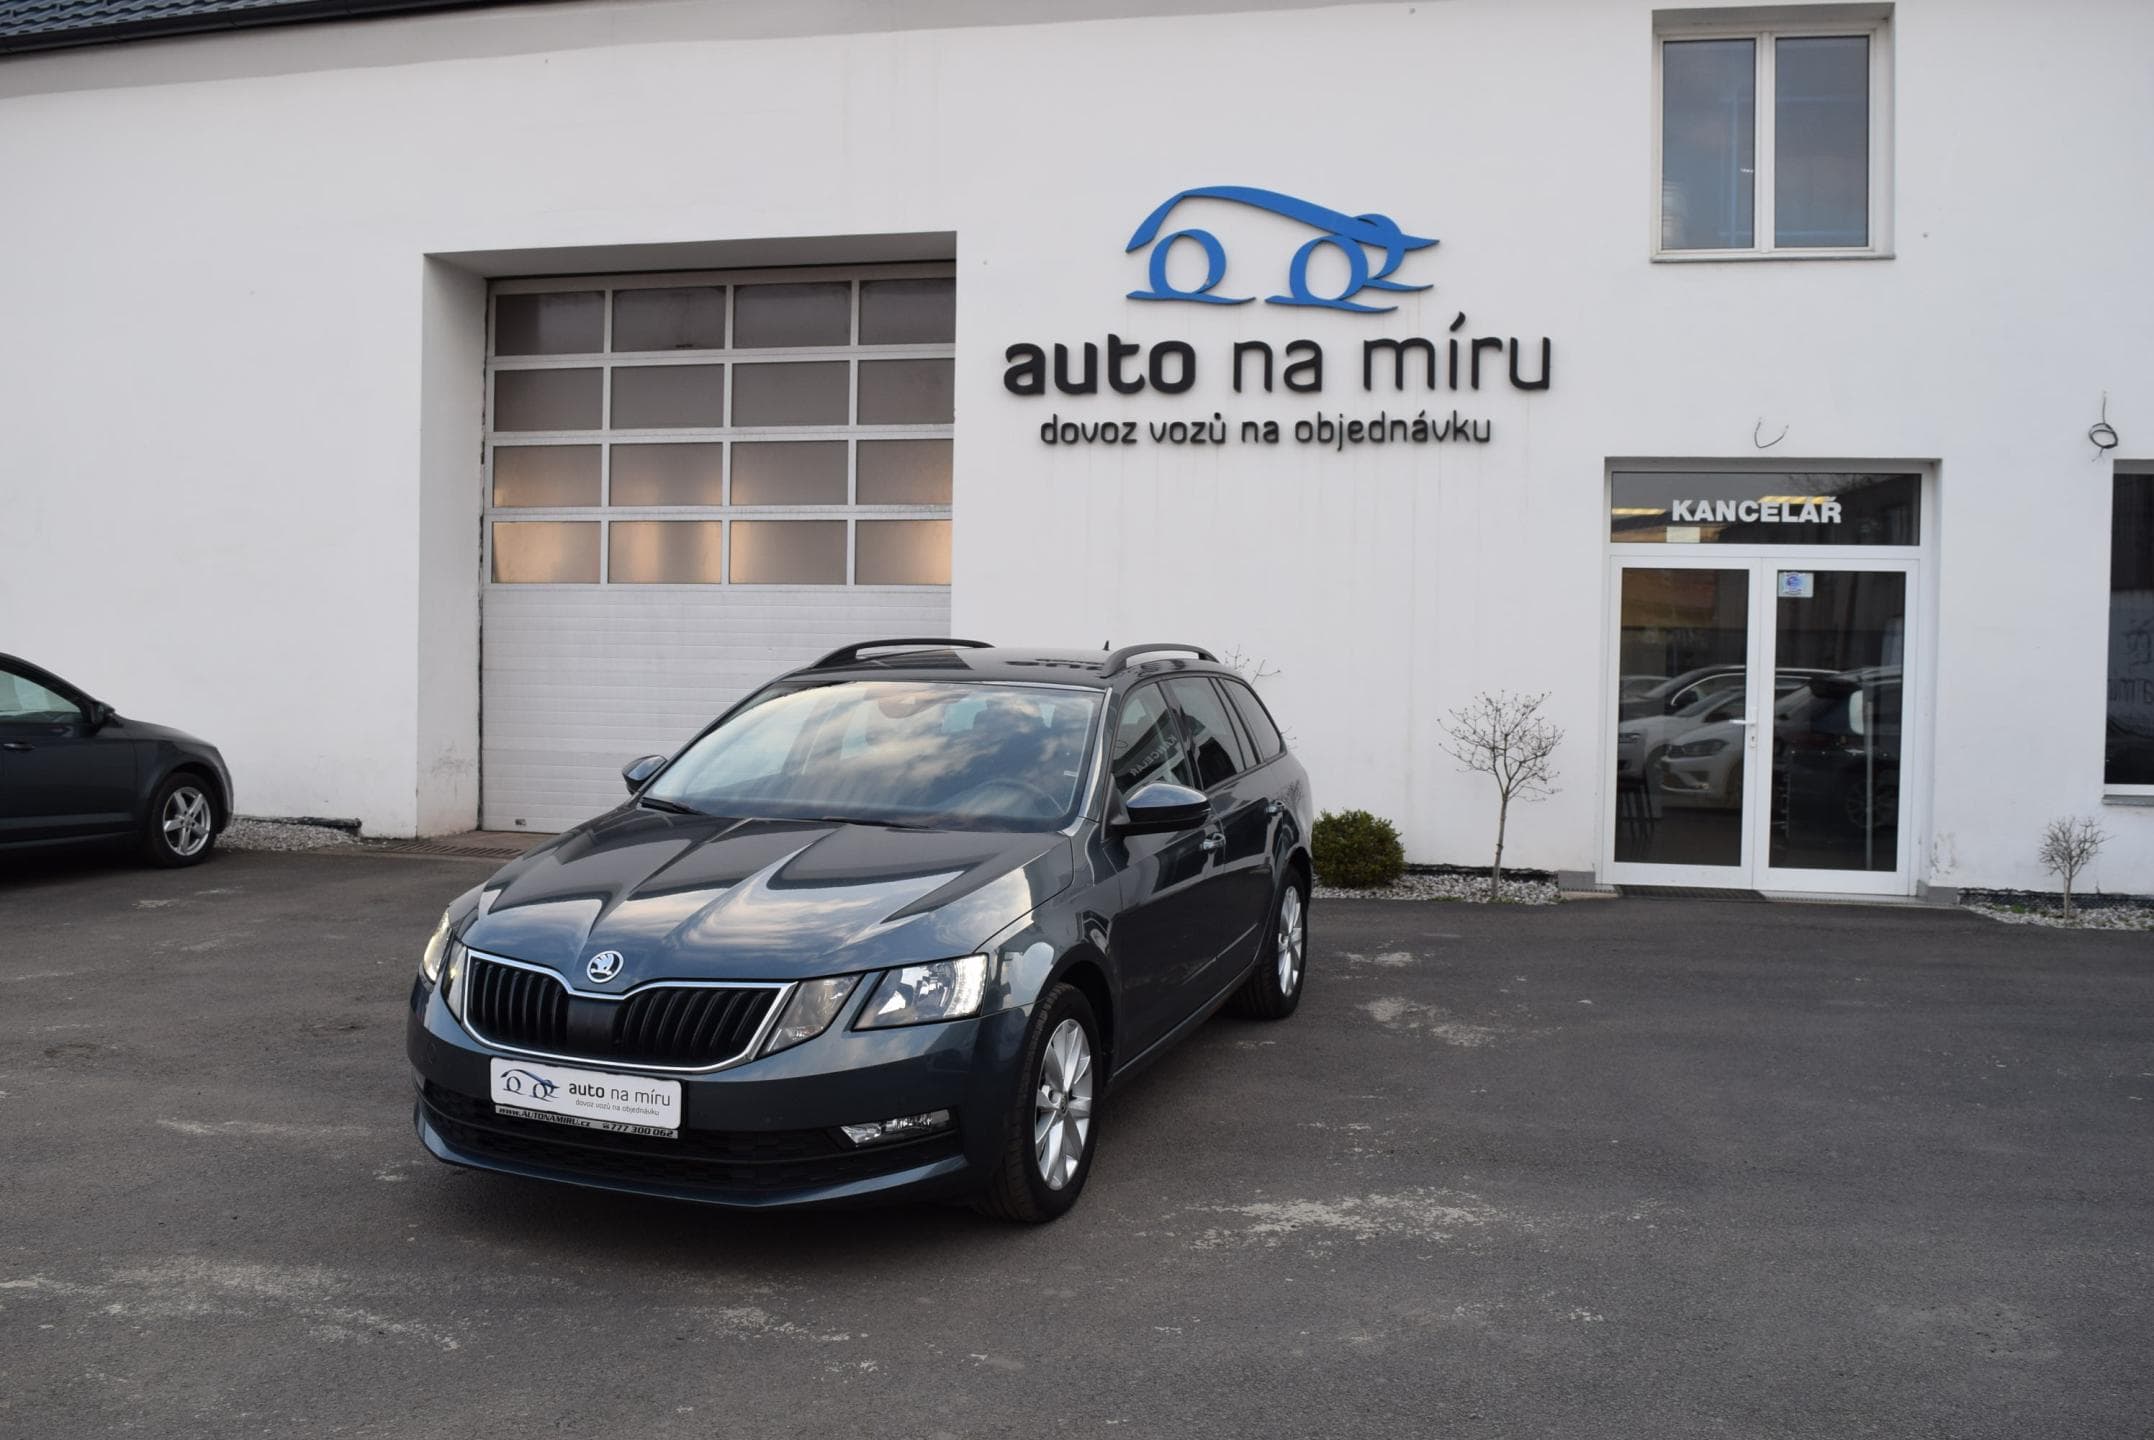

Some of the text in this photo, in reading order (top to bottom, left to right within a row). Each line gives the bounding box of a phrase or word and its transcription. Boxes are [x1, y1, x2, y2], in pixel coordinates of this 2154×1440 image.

[1003, 311, 1551, 396] auto na míru
[1040, 410, 1491, 452] dovoz vozů na objednávku
[568, 1082, 671, 1107] auto na míru
[575, 1098, 594, 1108] dovoz
[631, 1126, 651, 1135] 300
